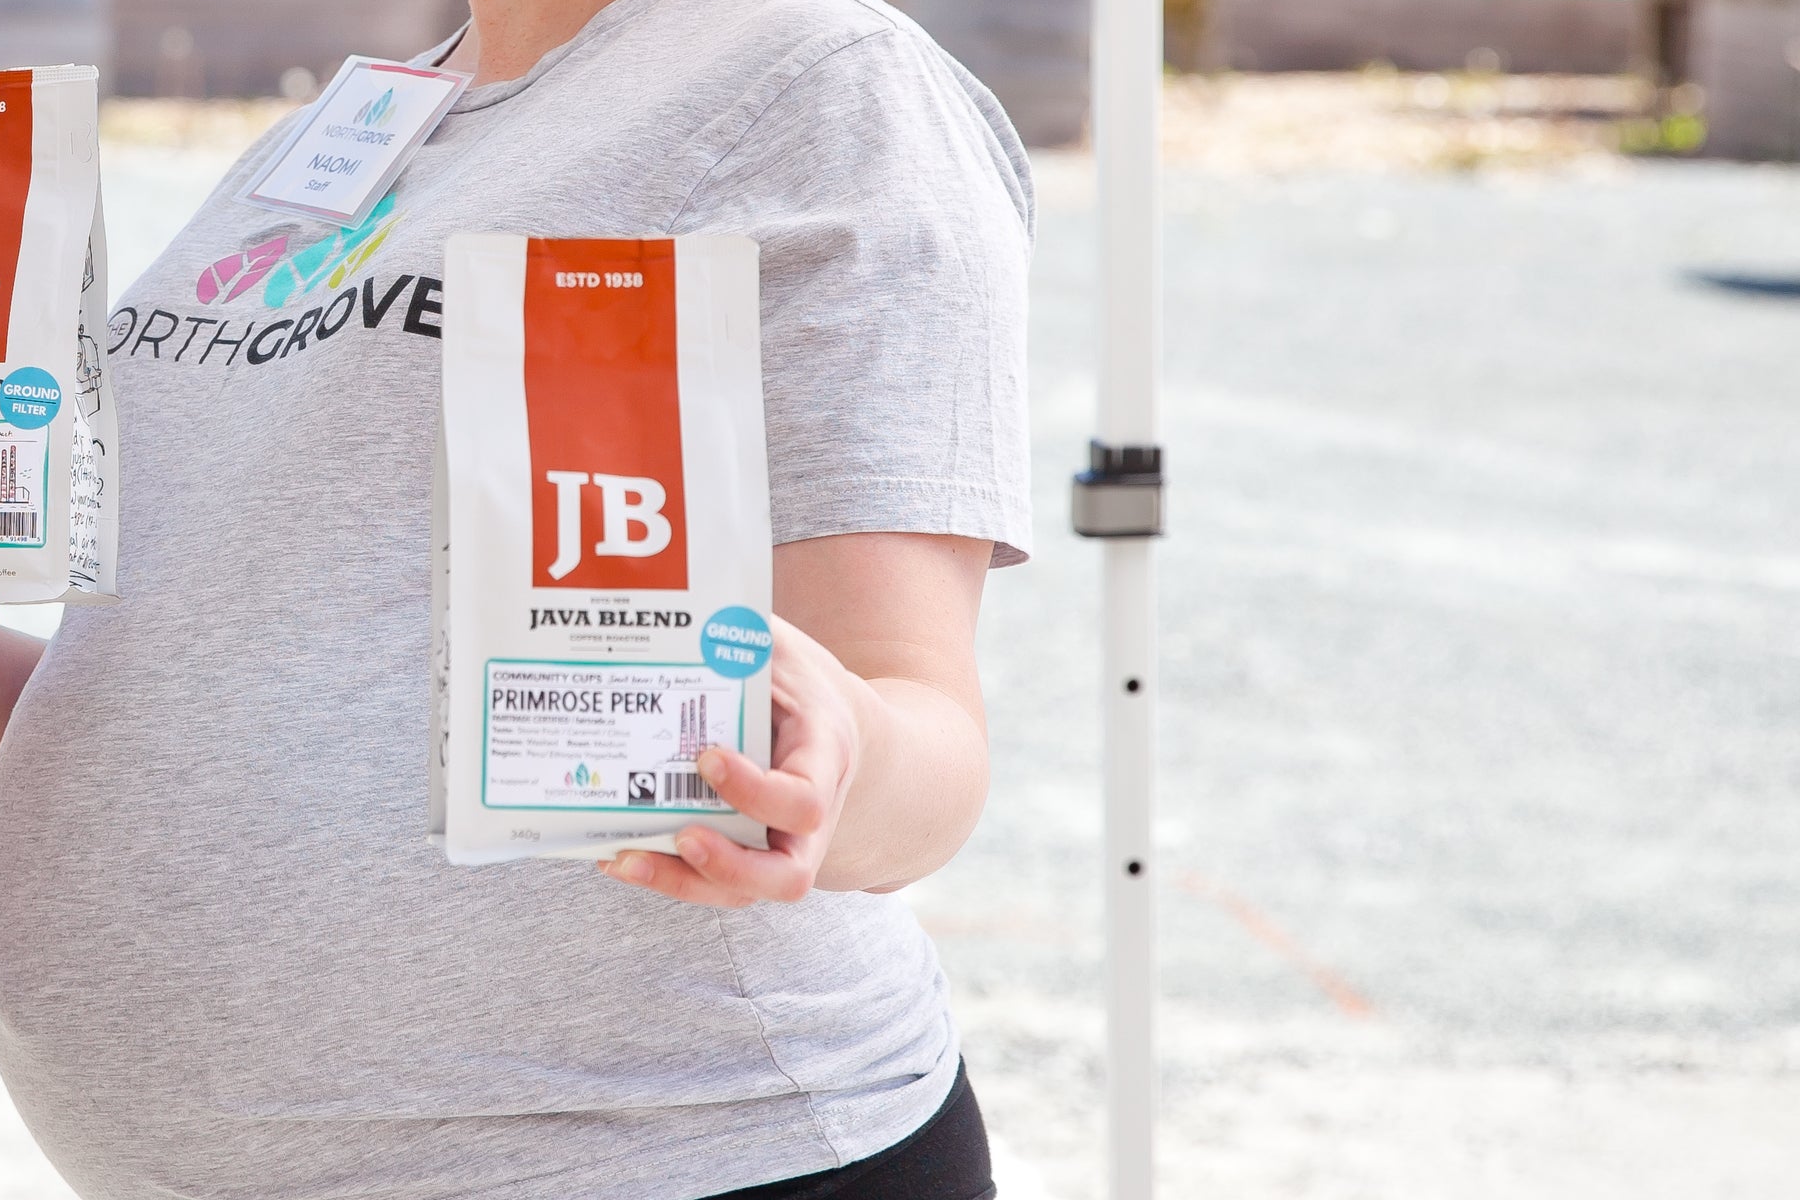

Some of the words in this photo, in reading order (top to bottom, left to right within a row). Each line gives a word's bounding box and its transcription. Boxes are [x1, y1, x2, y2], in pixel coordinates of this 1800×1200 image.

[307, 153, 363, 176] NAOMI
[555, 271, 600, 288] ESTD
[604, 271, 644, 288] 1938
[107, 274, 443, 366] ORTHGROVE
[3, 383, 60, 400] GROUND
[12, 403, 47, 417] FILTER
[546, 469, 672, 581] JB
[529, 609, 592, 630] JAVA
[598, 609, 692, 628] BLEND
[706, 623, 772, 647] GROUND
[714, 647, 755, 665] FILTER
[493, 671, 569, 682] COMMUNITY
[572, 672, 603, 683] CUPS
[492, 689, 603, 713] PRIMROSE
[611, 692, 663, 714] PERK
